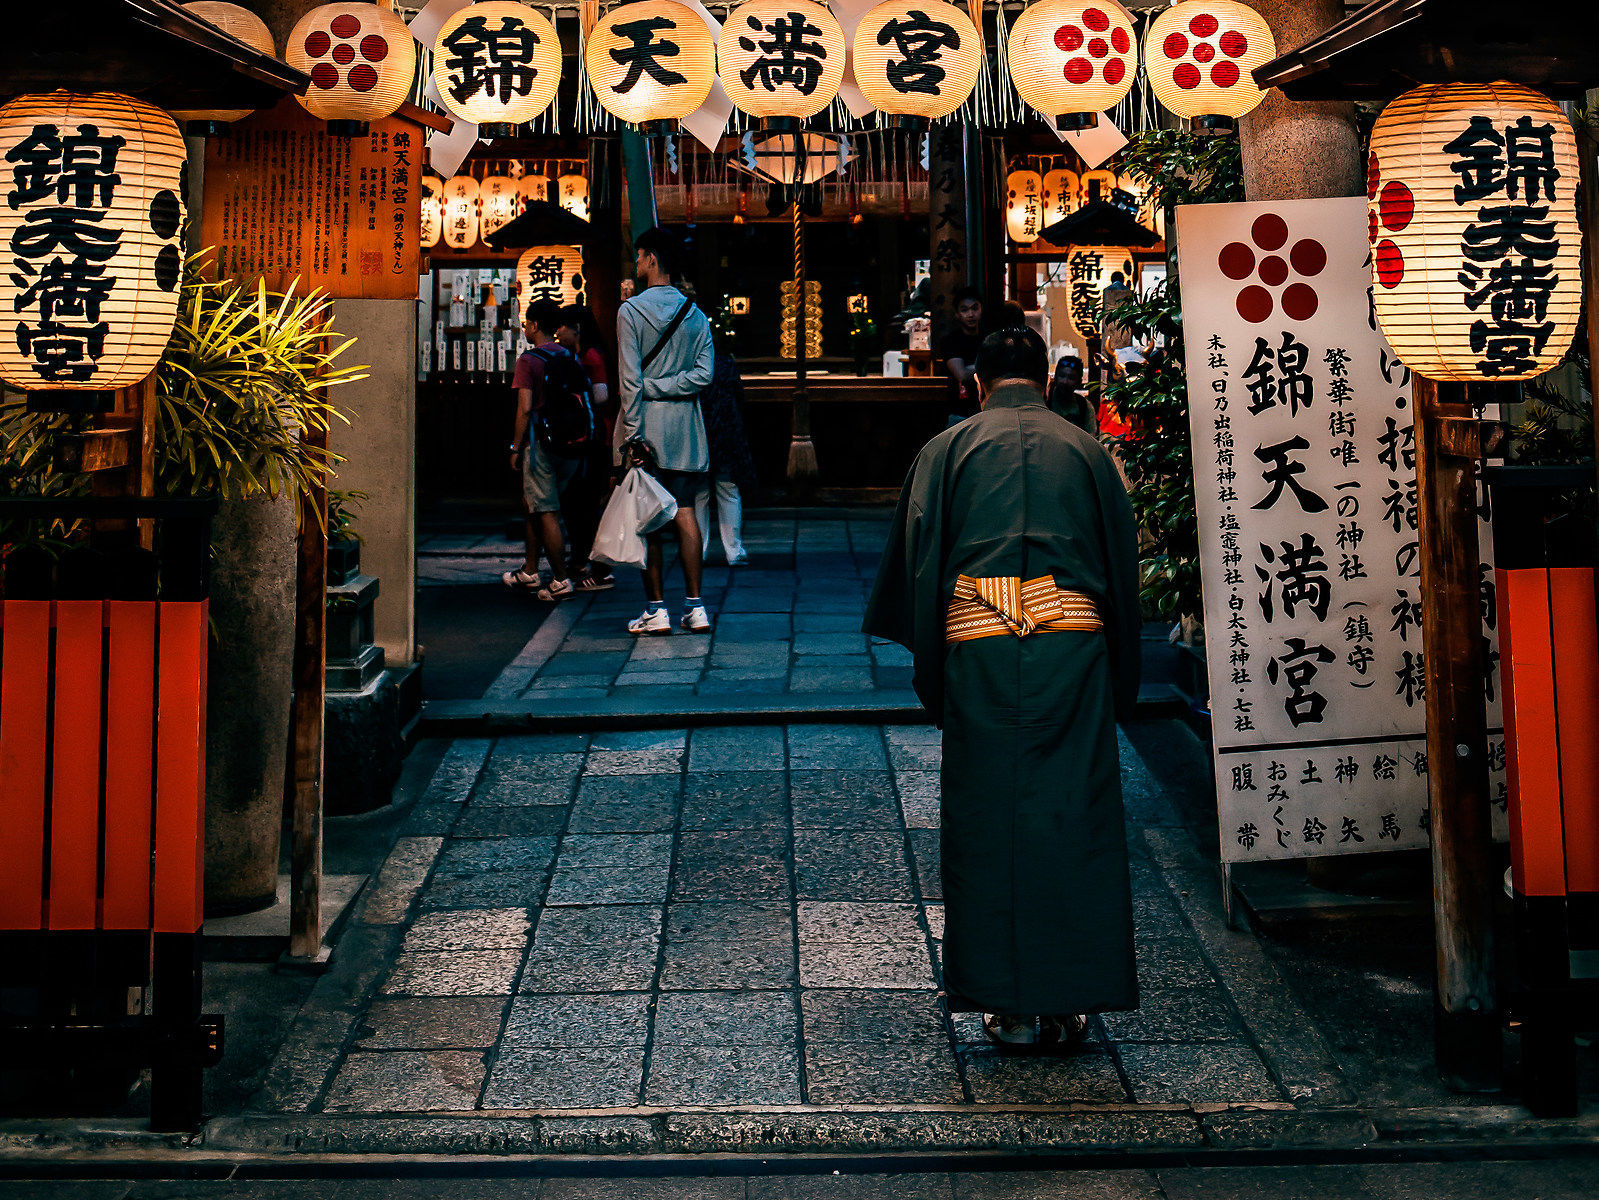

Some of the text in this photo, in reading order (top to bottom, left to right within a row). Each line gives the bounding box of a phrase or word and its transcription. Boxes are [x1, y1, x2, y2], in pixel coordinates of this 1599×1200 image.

[5, 124, 127, 382] 錦天満宮
[1442, 116, 1562, 377] 錦天満宮
[1240, 330, 1337, 730] 錦天満宮
[1267, 761, 1290, 849] おみくじ
[1300, 759, 1328, 844] 土鈴
[1334, 756, 1365, 843] 神矢
[1372, 754, 1401, 842] 絵馬
